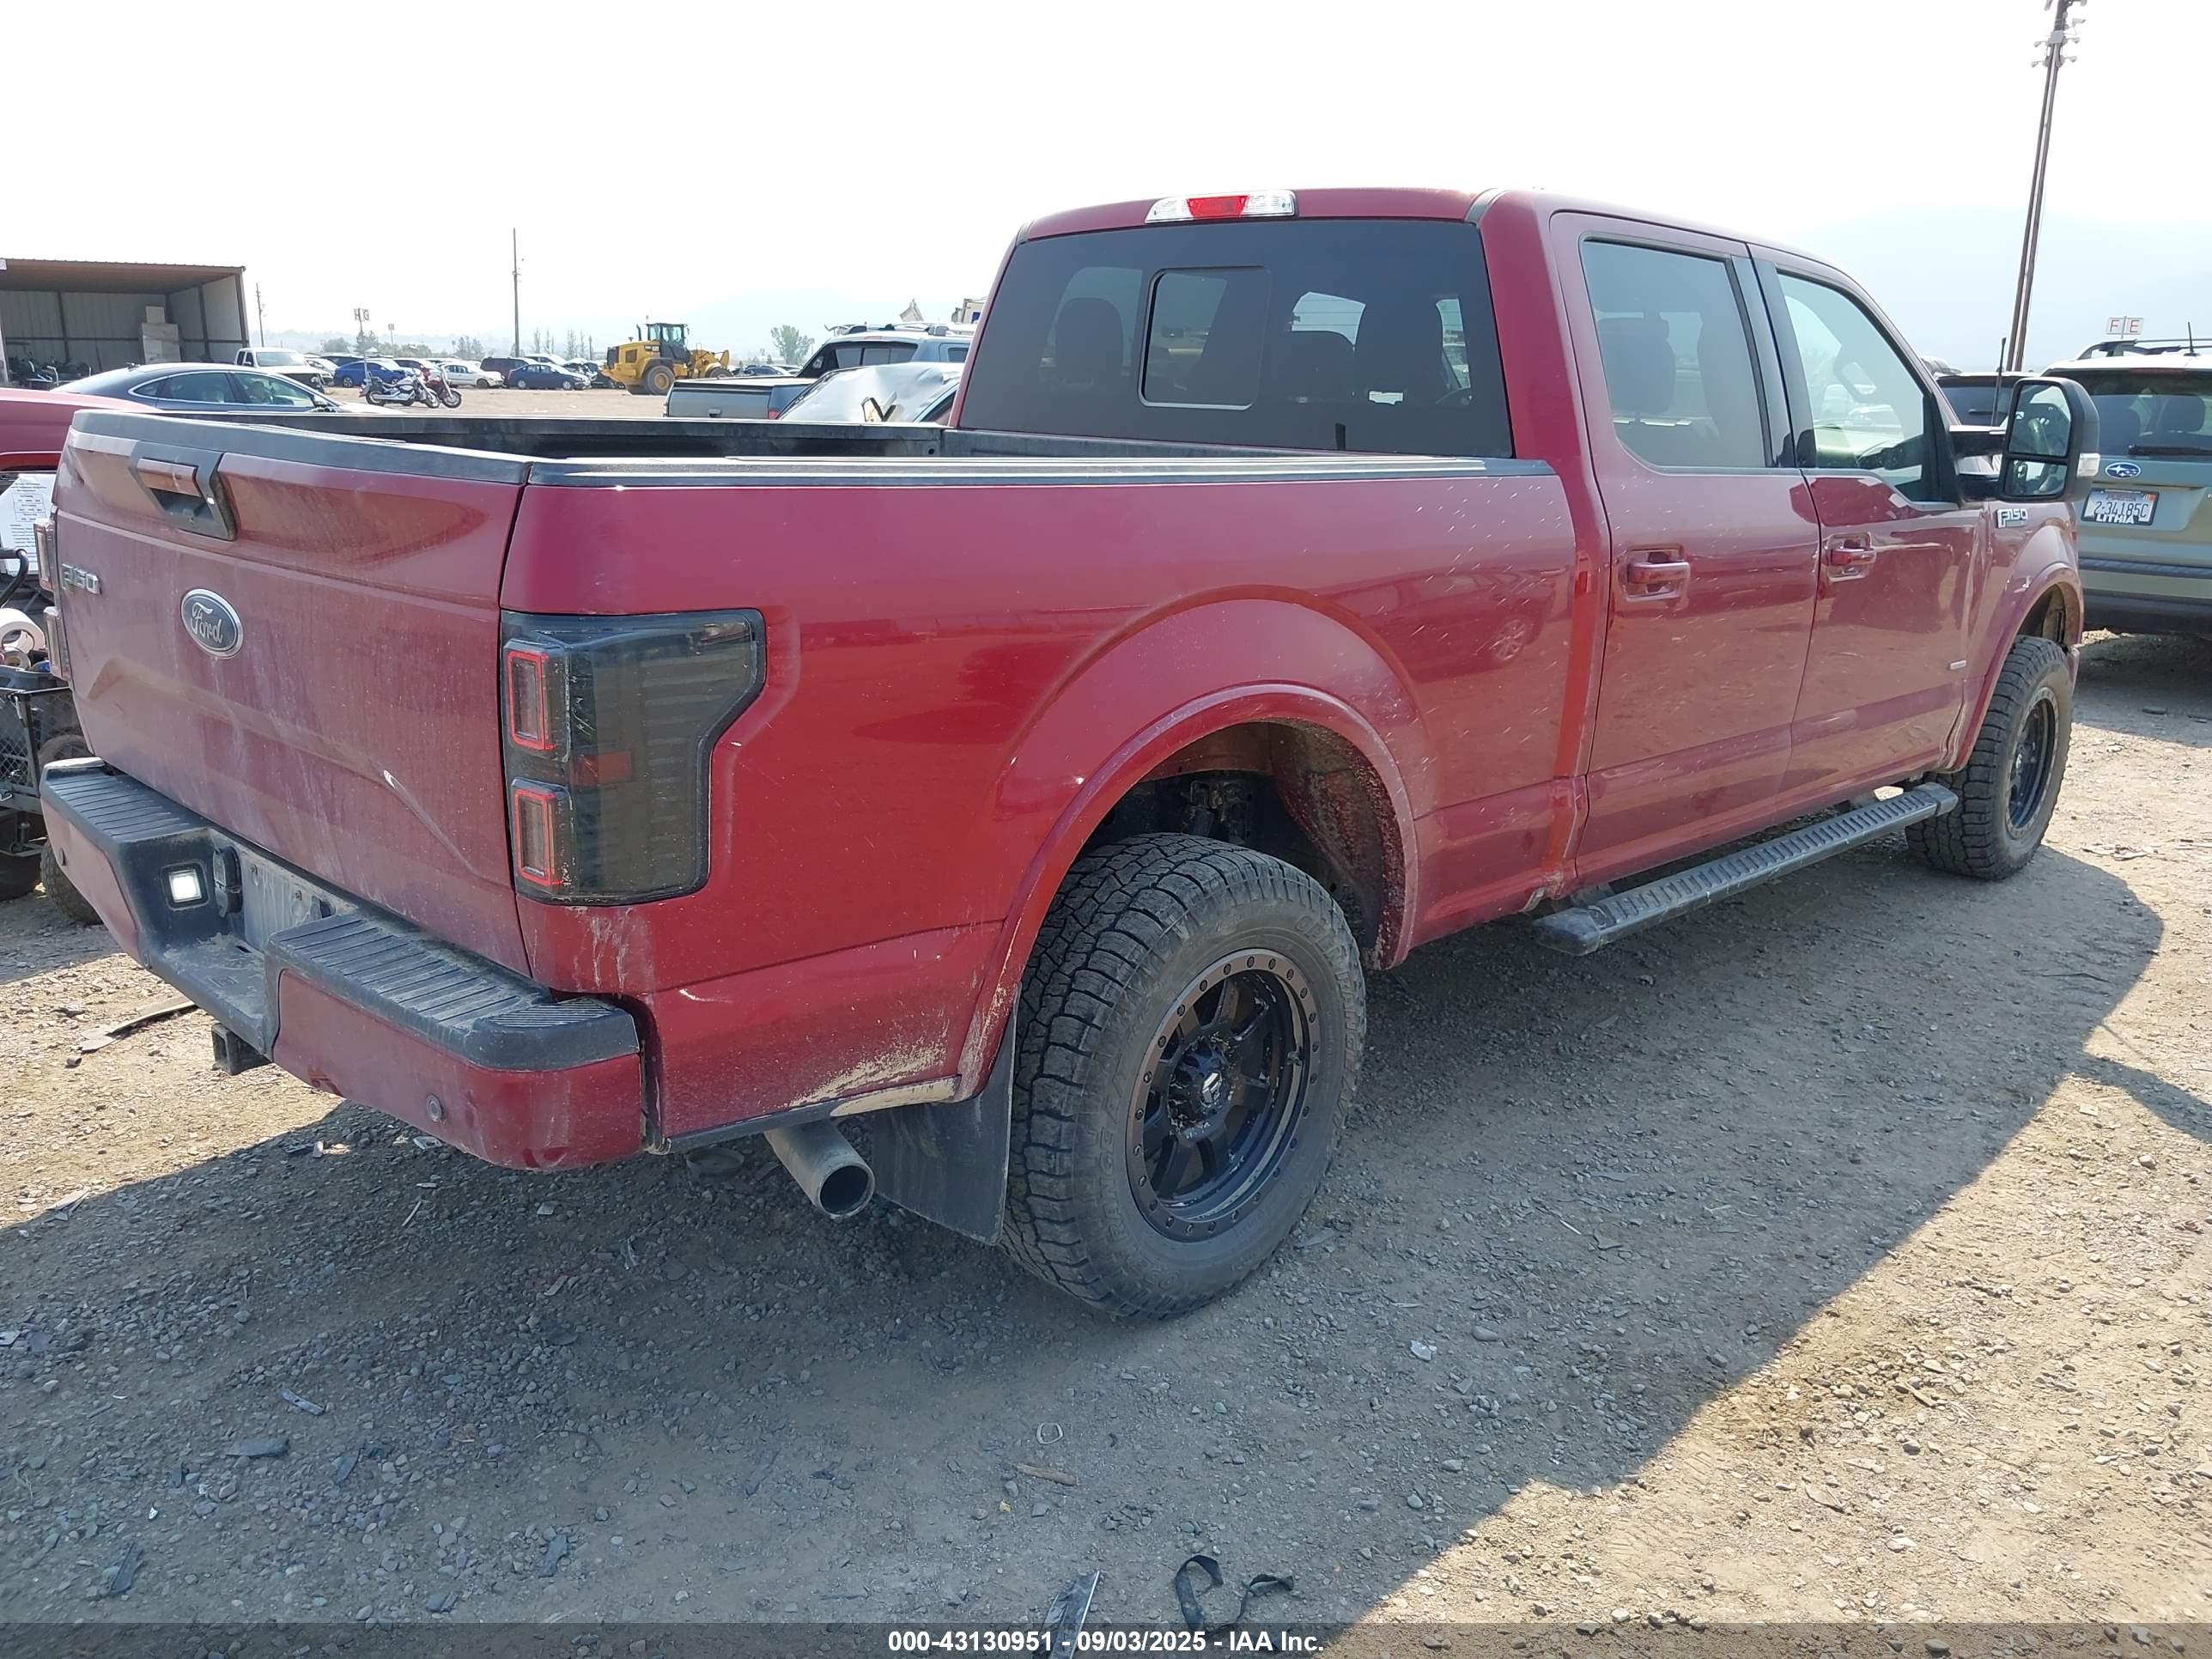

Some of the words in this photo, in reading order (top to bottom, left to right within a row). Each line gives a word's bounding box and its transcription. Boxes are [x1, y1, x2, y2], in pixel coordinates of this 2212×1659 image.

[2110, 319, 2120, 332] F
[2130, 319, 2141, 333] E
[2095, 514, 2135, 525] LITHIA
[190, 602, 223, 644] Ford
